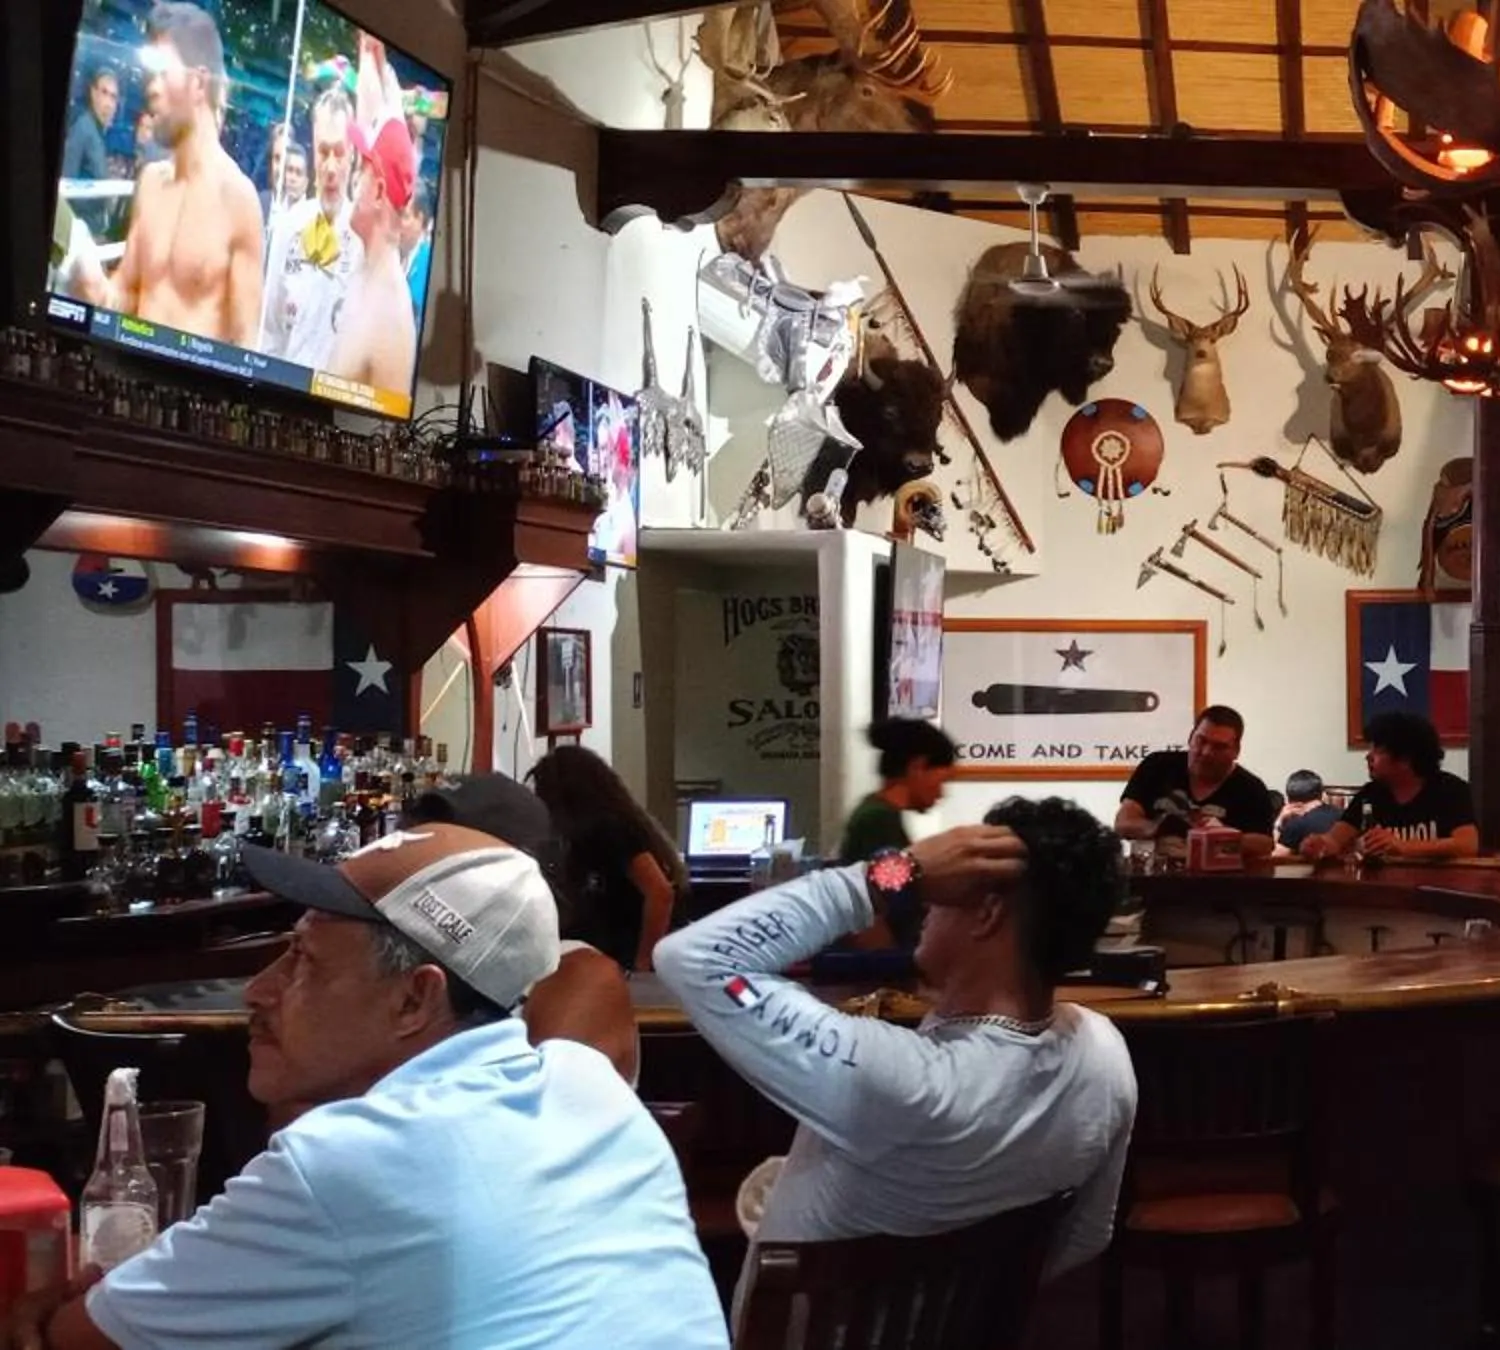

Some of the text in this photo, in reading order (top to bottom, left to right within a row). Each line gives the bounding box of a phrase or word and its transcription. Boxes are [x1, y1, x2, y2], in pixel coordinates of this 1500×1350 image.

[955, 743, 1017, 759] COME
[1032, 743, 1083, 759] AND
[1095, 745, 1150, 760] TAKE
[750, 992, 859, 1069] TOMMY
